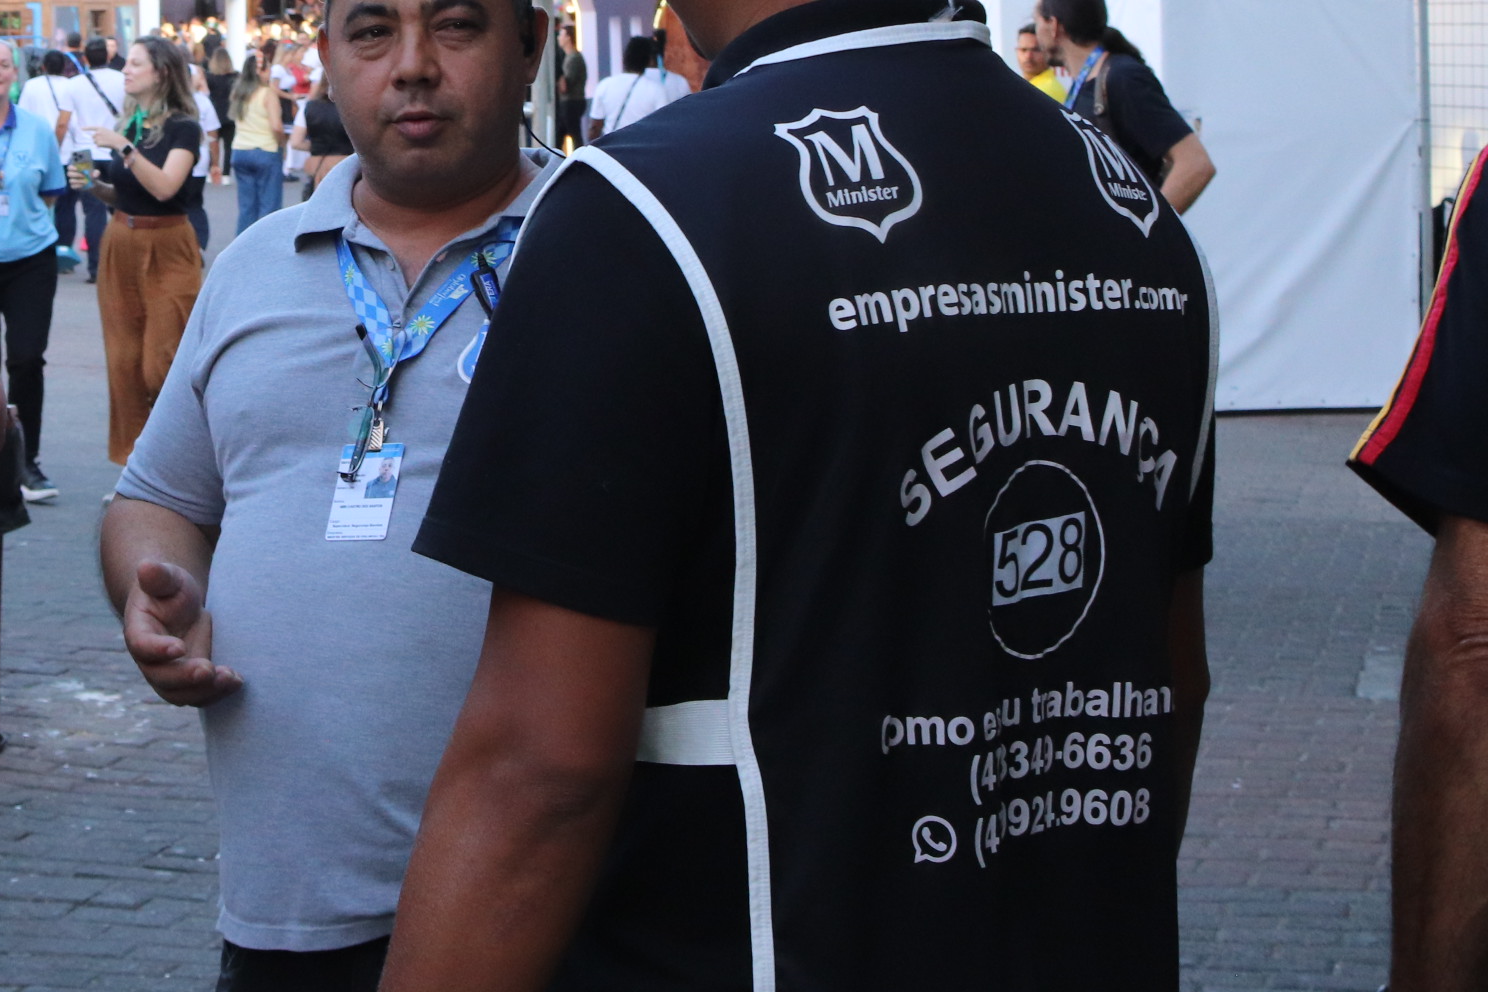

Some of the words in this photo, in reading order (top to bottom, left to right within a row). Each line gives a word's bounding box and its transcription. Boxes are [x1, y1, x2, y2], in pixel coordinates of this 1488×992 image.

[804, 123, 885, 187] M
[825, 185, 900, 208] Minister
[900, 378, 1178, 527] SEGURANÇA
[994, 516, 1084, 598] 528
